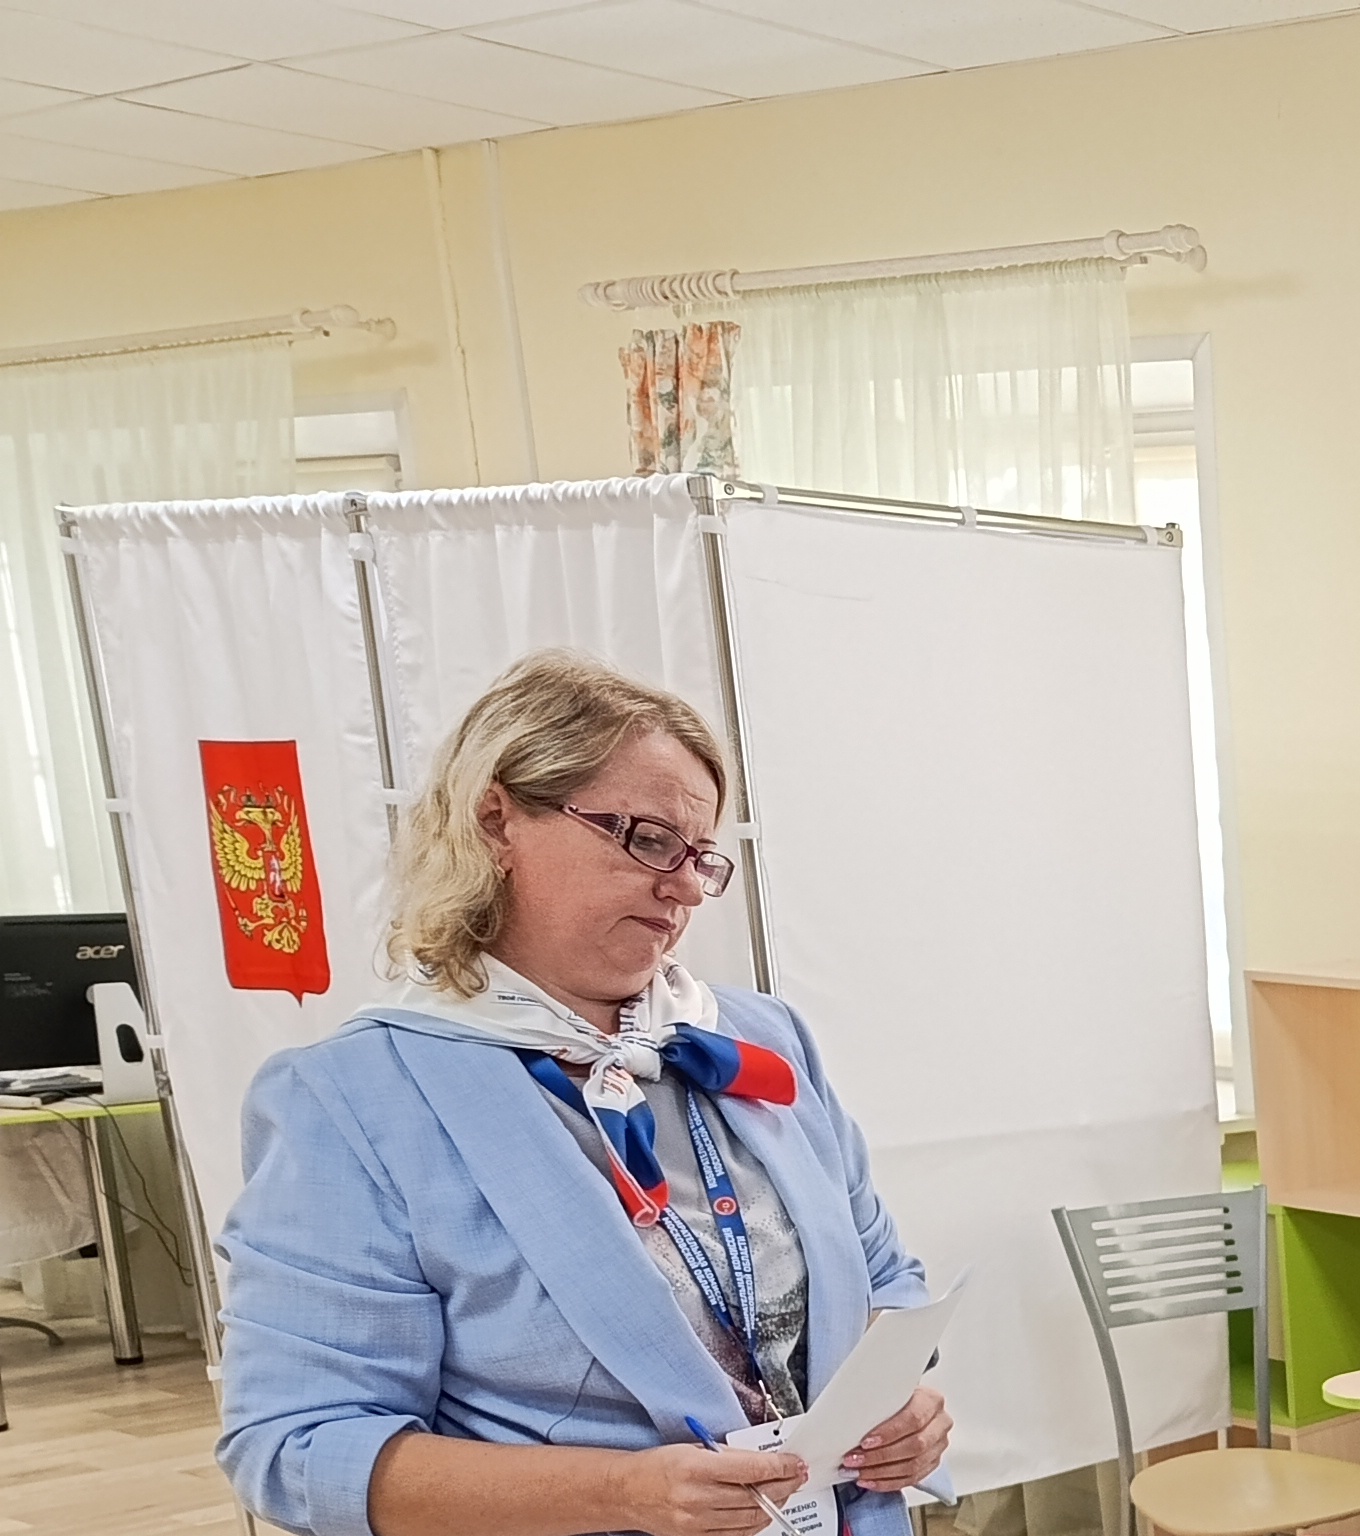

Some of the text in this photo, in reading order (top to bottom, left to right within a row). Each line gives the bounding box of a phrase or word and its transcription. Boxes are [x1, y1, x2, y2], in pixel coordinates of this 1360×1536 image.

[75, 944, 126, 960] acer
[698, 1125, 726, 1177] МОСКОВСКОЙ
[661, 1216, 718, 1306] МОСКОВСКОЙ ОБЛАСТИ
[664, 1206, 727, 1313] ИЗБИРАТЕЛЬНАЯ КОМИССИЯ
[721, 1227, 742, 1271] КОМИССИЯ
[735, 1235, 752, 1273] ОБЛАСТИ
[781, 1500, 818, 1516] УРЖЕНКО
